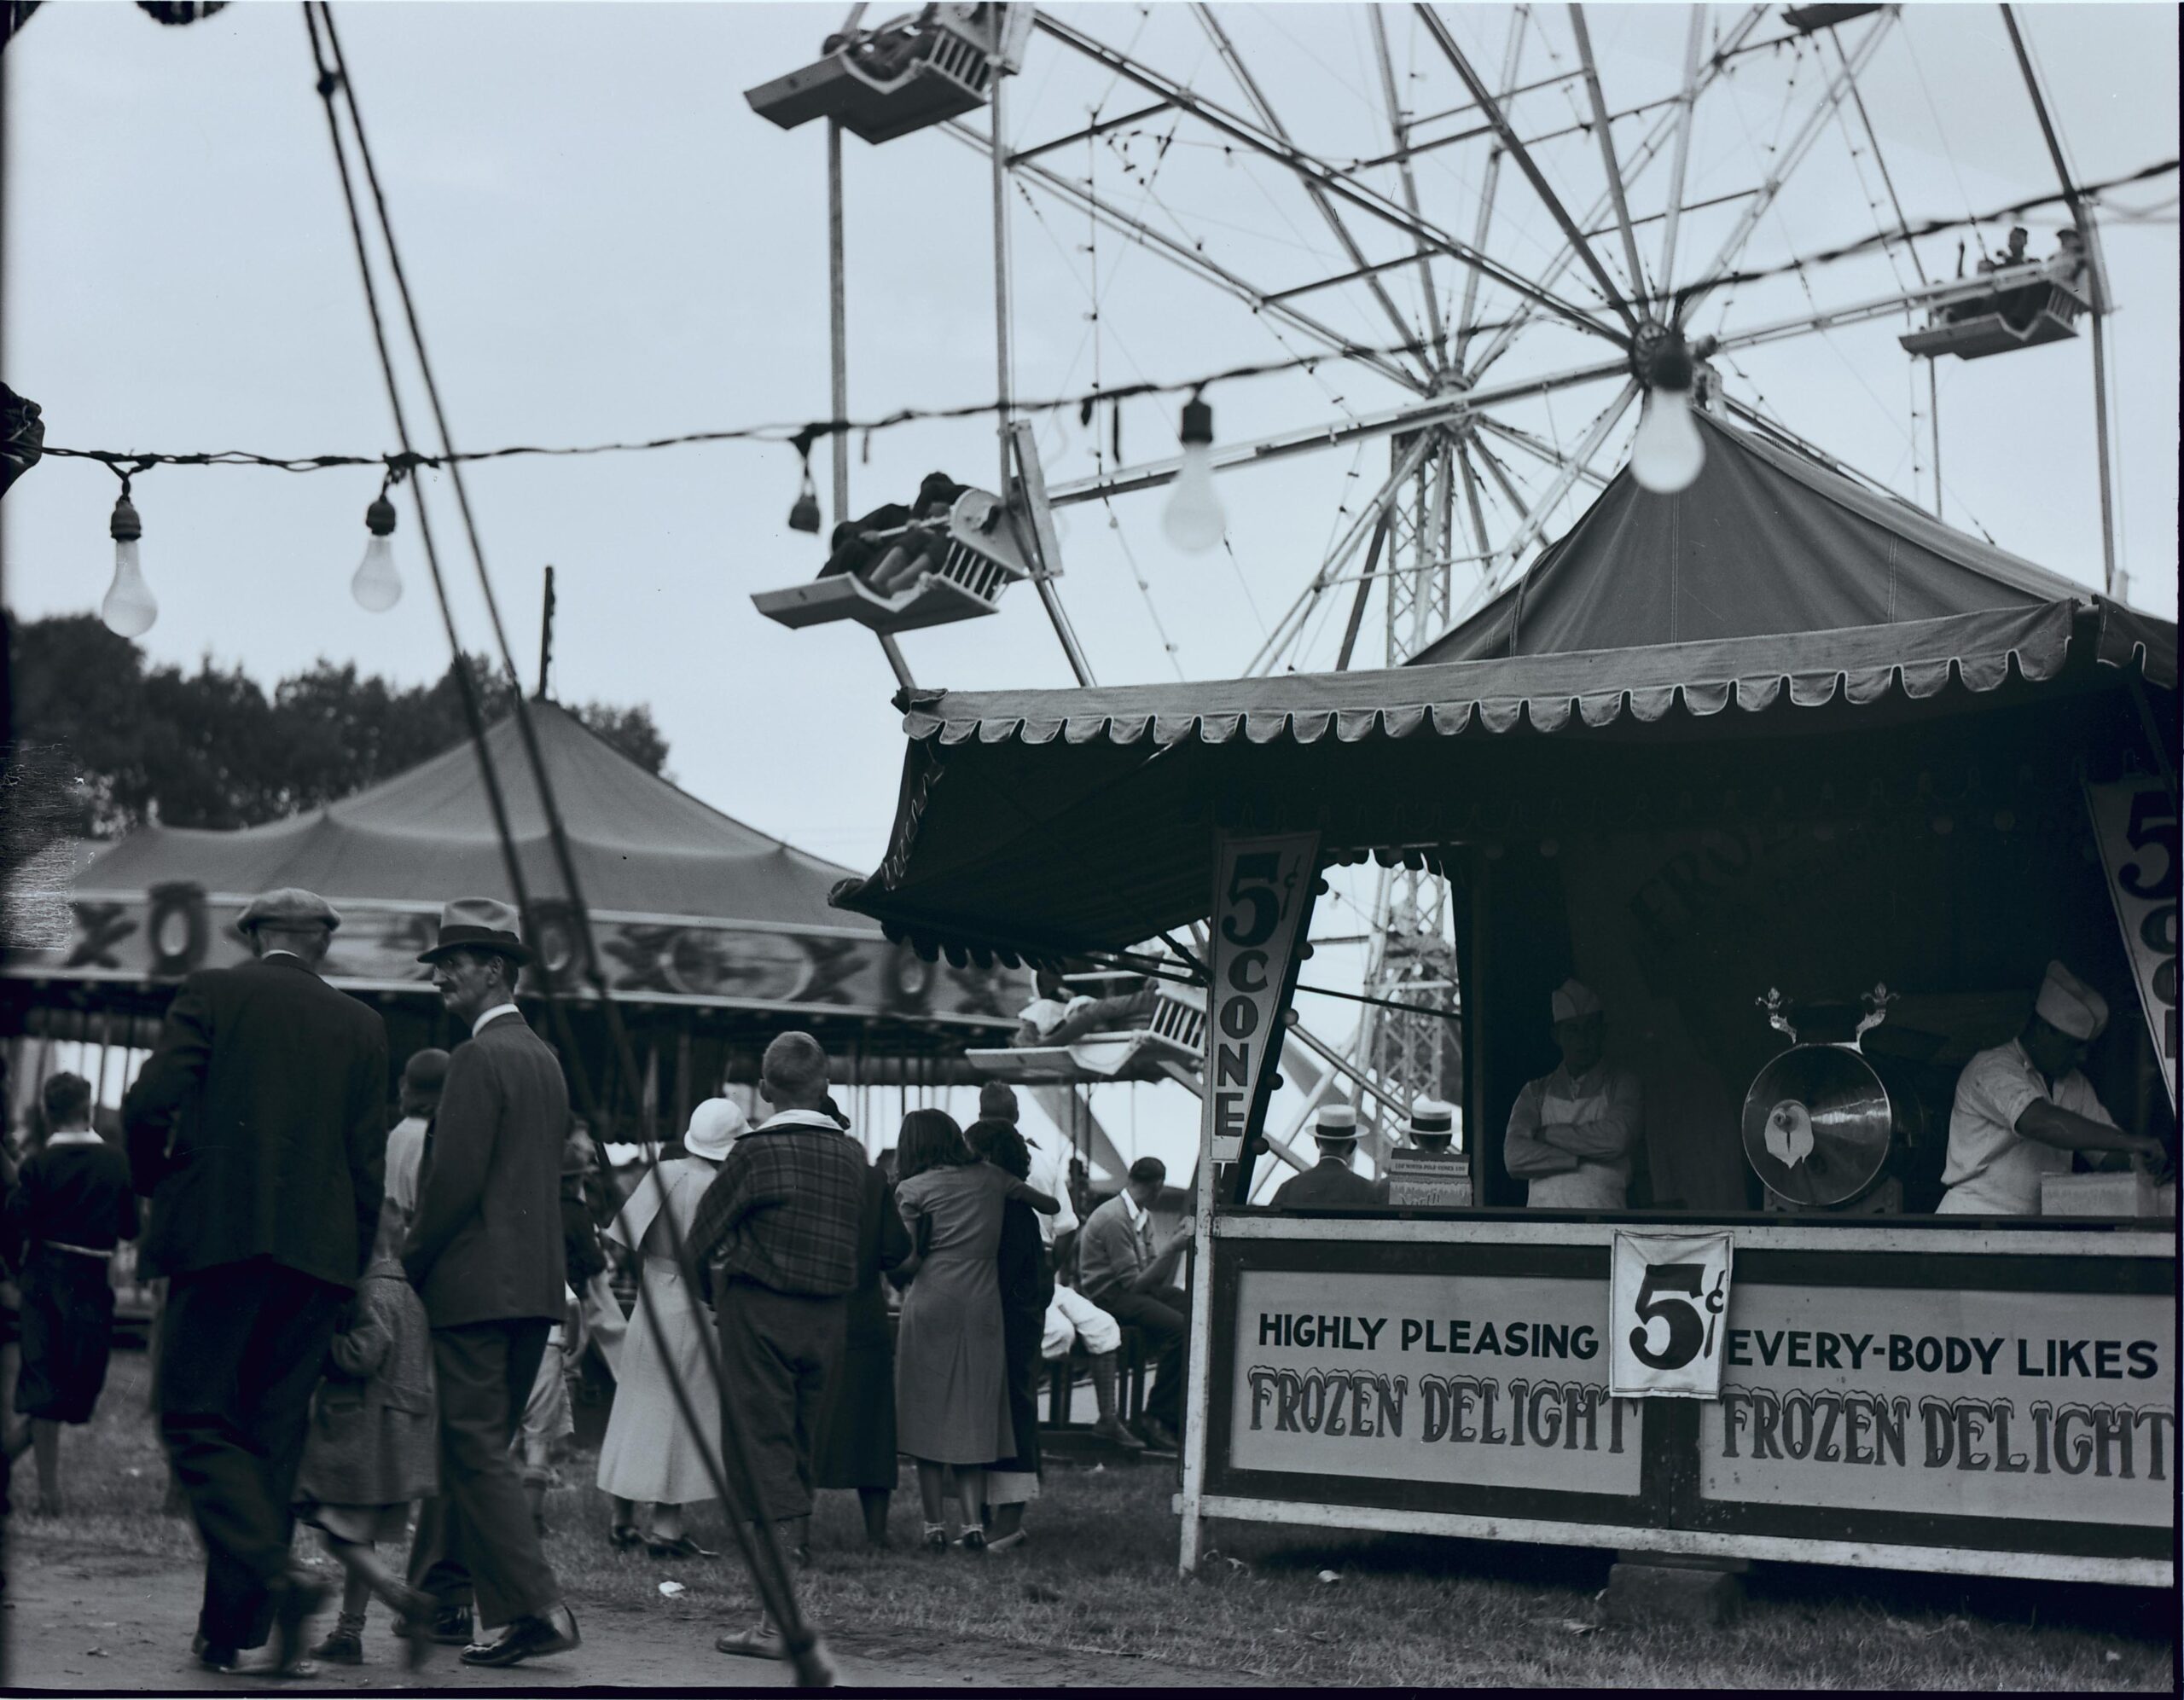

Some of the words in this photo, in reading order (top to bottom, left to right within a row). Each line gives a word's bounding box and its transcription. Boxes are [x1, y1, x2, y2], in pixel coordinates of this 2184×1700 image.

[1215, 949, 1269, 1137] CONE
[1259, 1314, 1387, 1351] HIGHLY
[1402, 1320, 1600, 1360] PLEASING
[1629, 1263, 1726, 1370] 5¢
[1728, 1329, 2005, 1376] EVERY-BODY
[2017, 1338, 2159, 1379] LIKES
[1247, 1365, 1409, 1438] FROZEN
[1419, 1373, 1639, 1454] DELIGHT
[1718, 1384, 1912, 1468] FROZEN
[1919, 1395, 2175, 1482] DELIGHT
